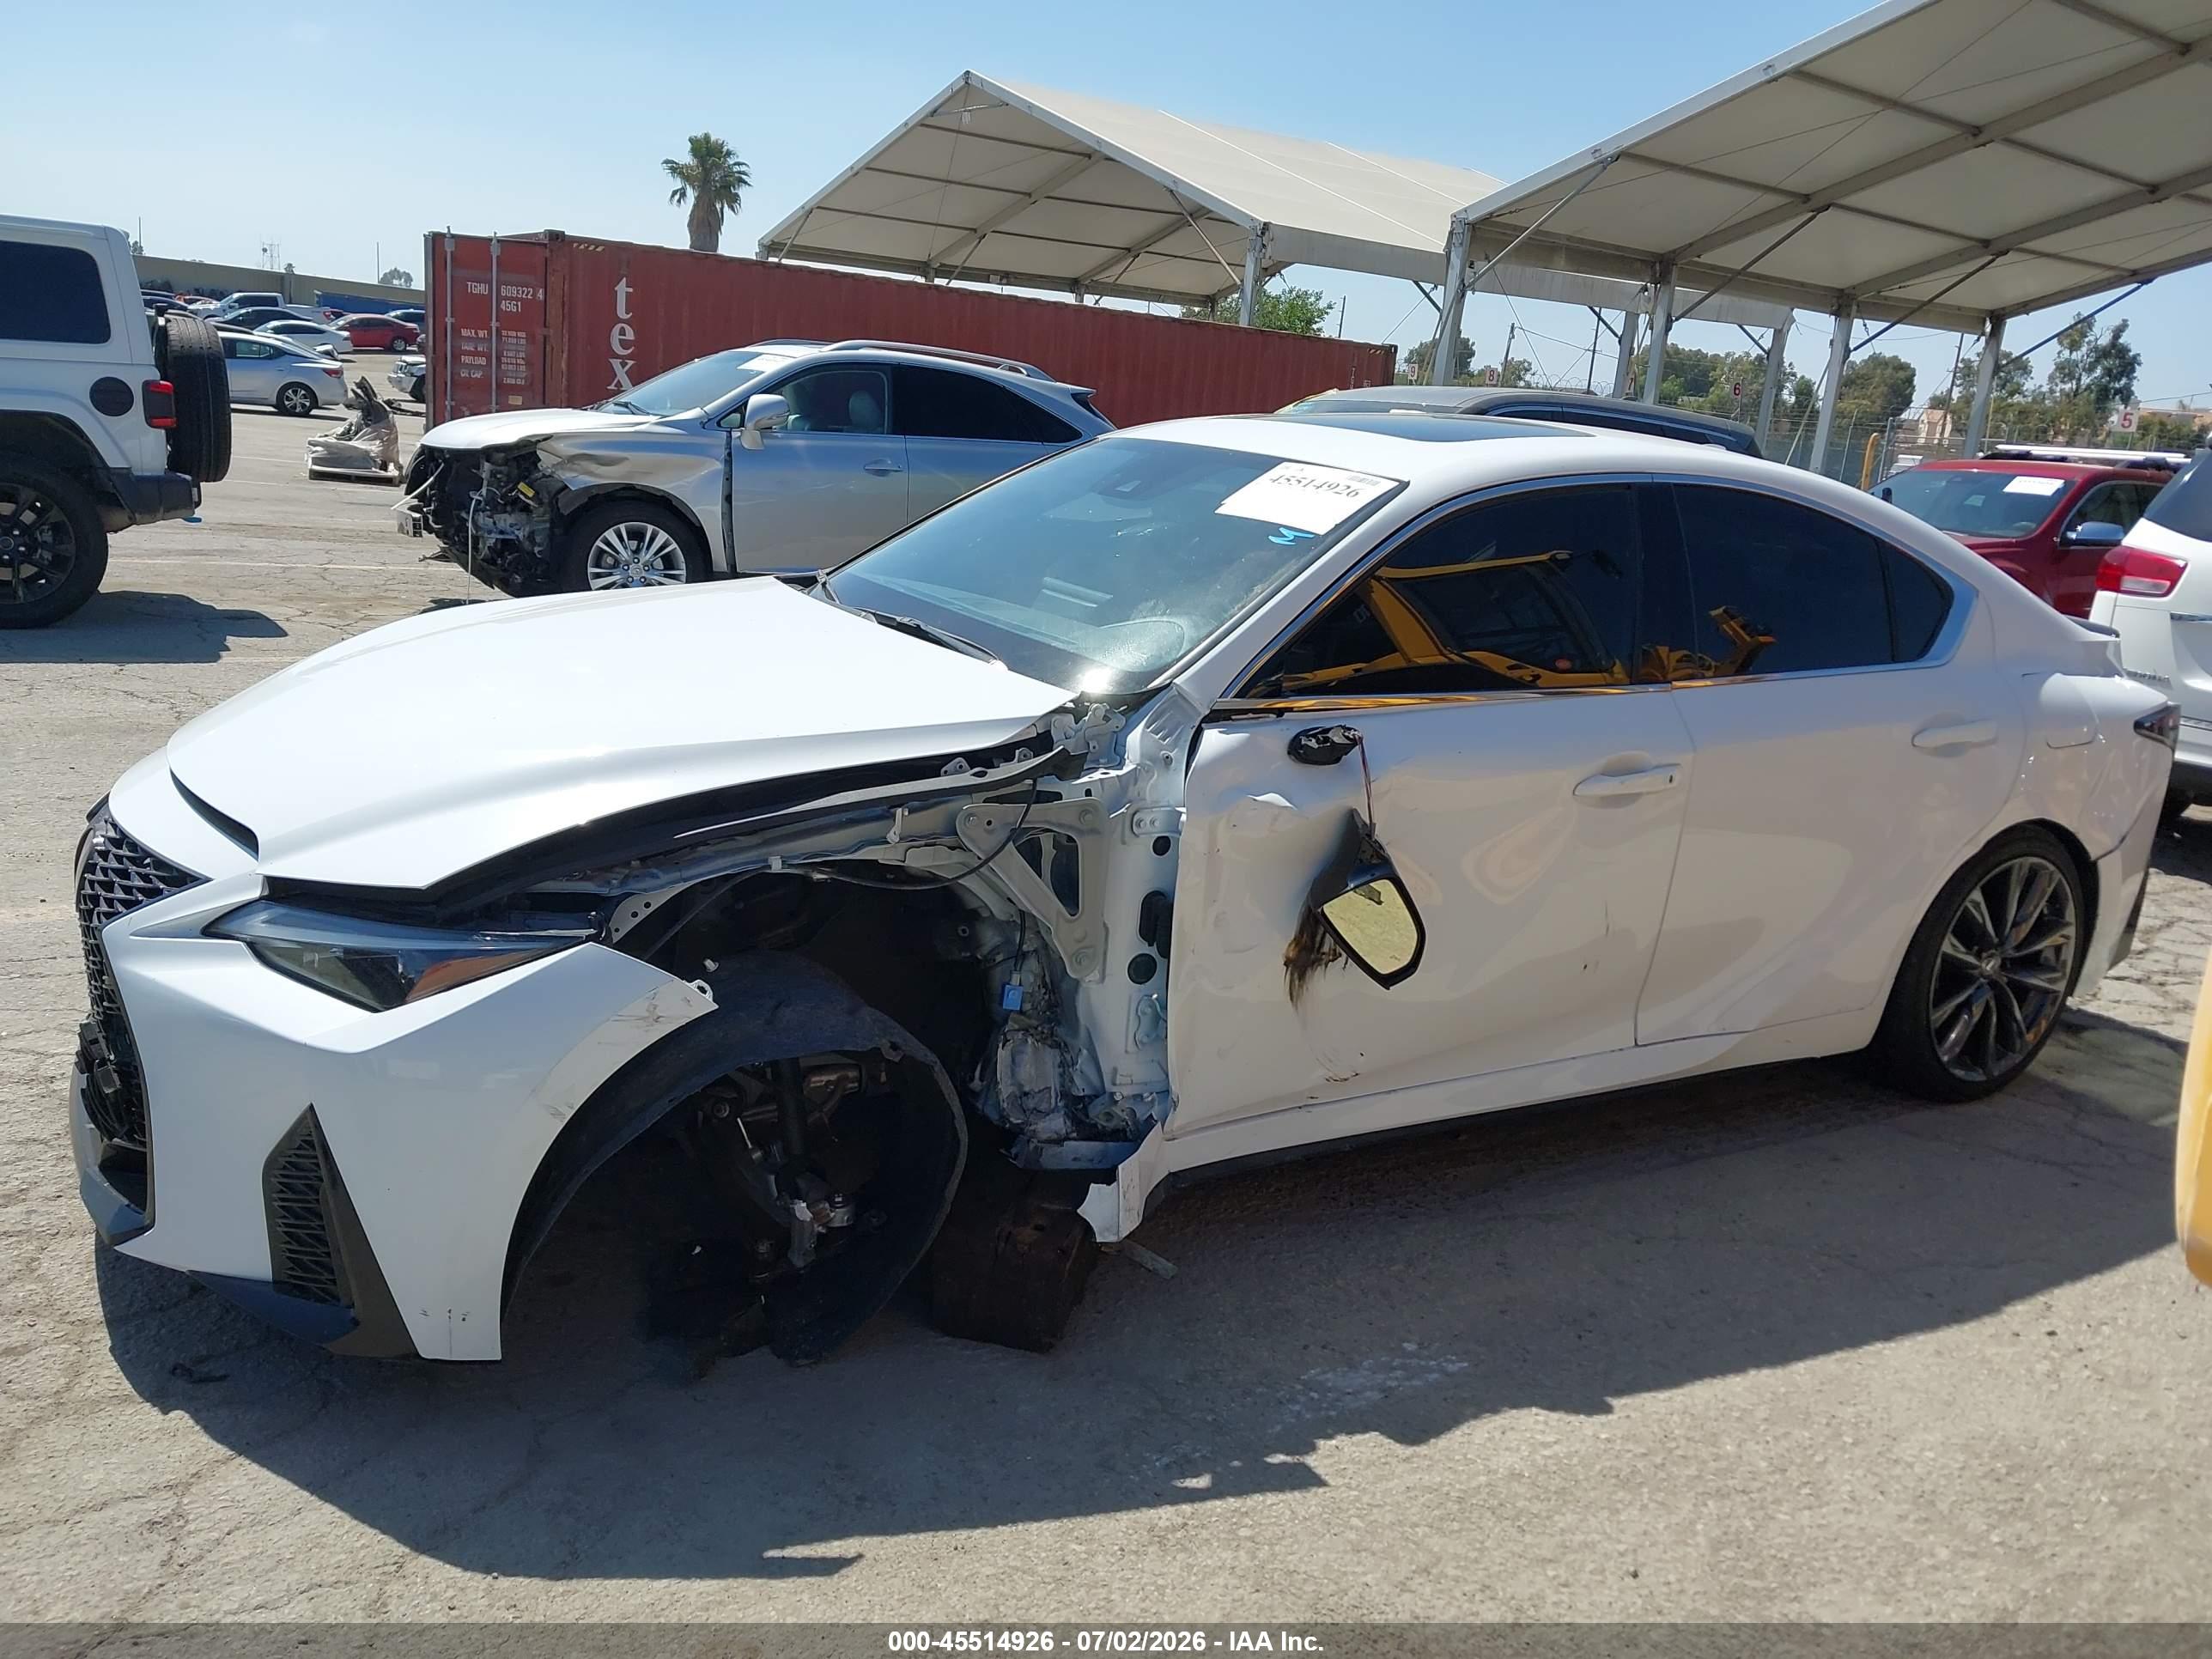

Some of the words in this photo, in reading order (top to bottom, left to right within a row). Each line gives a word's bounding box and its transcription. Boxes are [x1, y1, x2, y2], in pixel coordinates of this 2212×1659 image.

[466, 282, 489, 295] TGHU
[501, 285, 533, 299] 609322
[537, 288, 544, 301] 4
[500, 300, 521, 313] 45G1
[460, 355, 487, 366] PAYLOAD
[1410, 366, 1416, 378] 9
[1488, 369, 1495, 382] 8
[1733, 382, 1741, 397] 6
[2121, 412, 2134, 428] 5
[1269, 473, 1366, 498] 45514926
